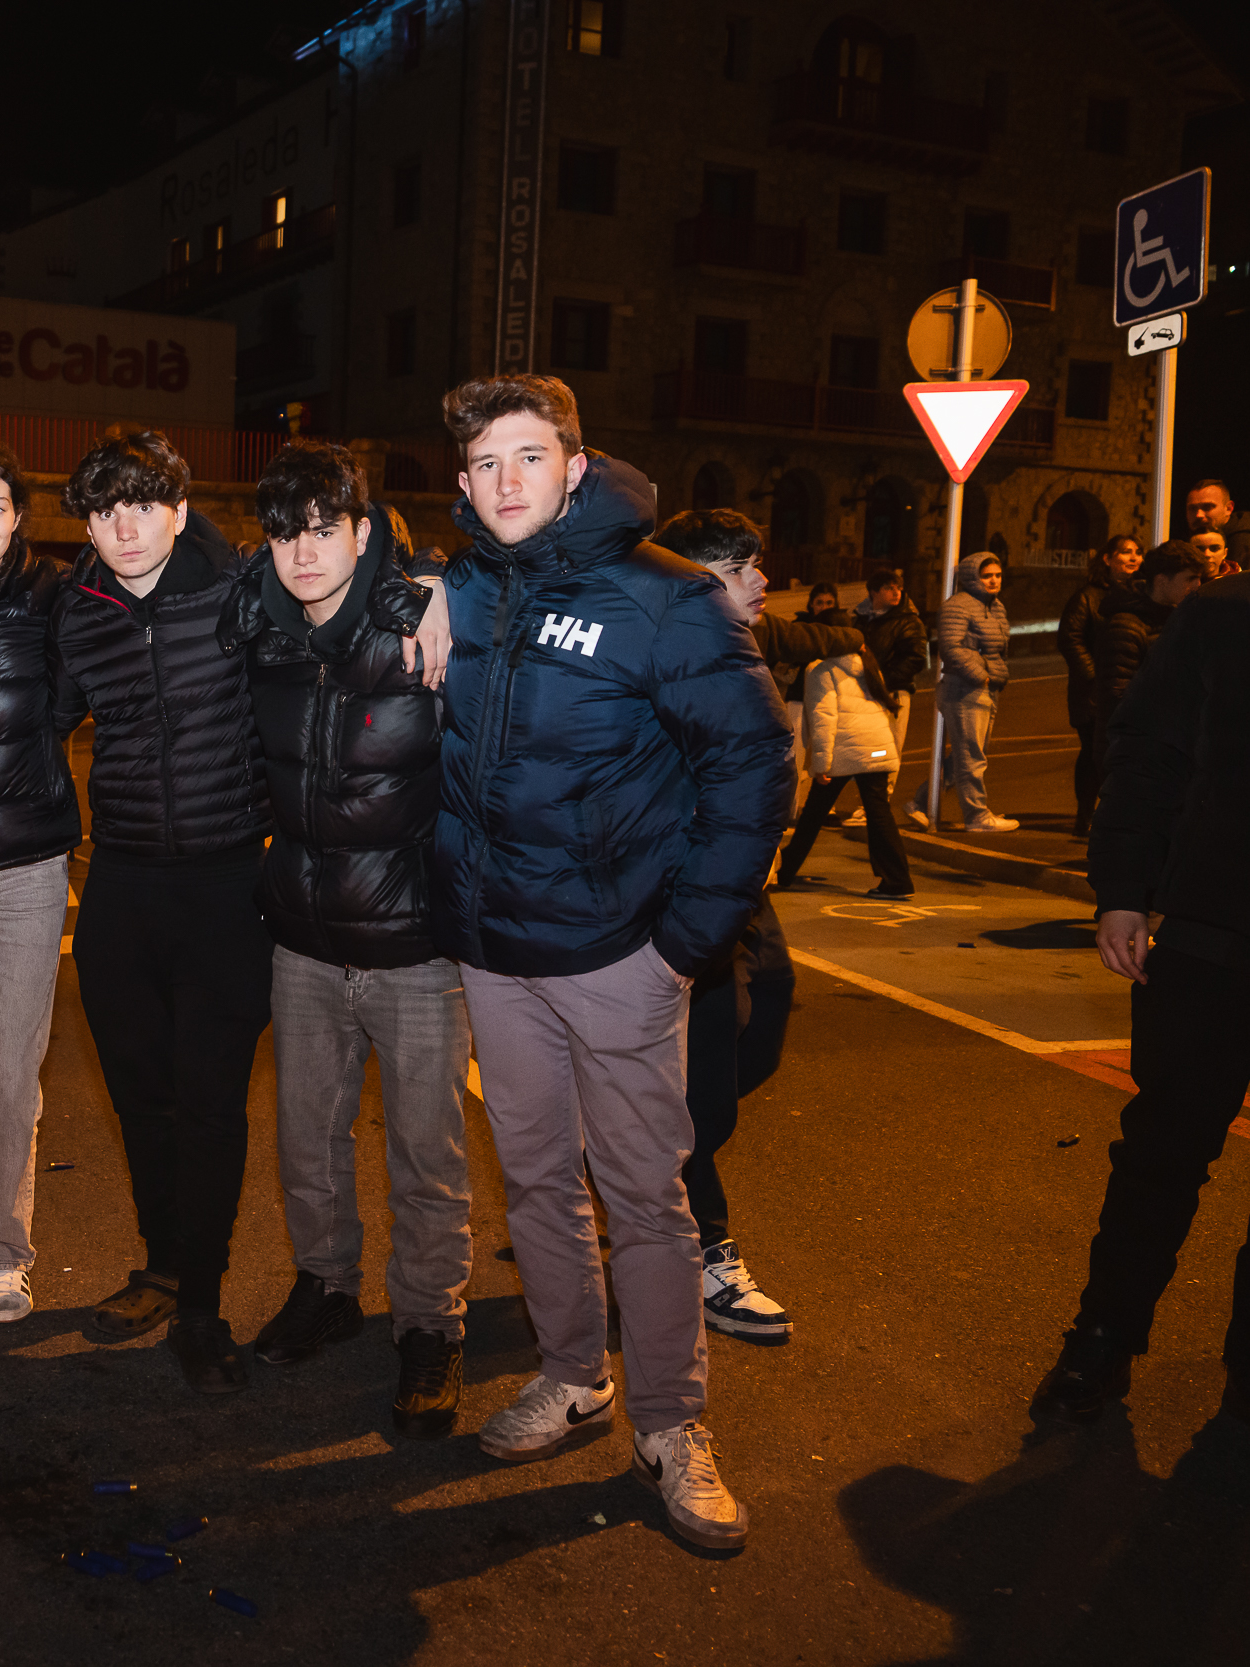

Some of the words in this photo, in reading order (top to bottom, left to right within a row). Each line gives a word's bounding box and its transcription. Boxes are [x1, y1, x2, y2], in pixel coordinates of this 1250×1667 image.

[161, 116, 299, 228] Rosaleda
[18, 327, 190, 393] Català
[537, 613, 604, 657] HH
